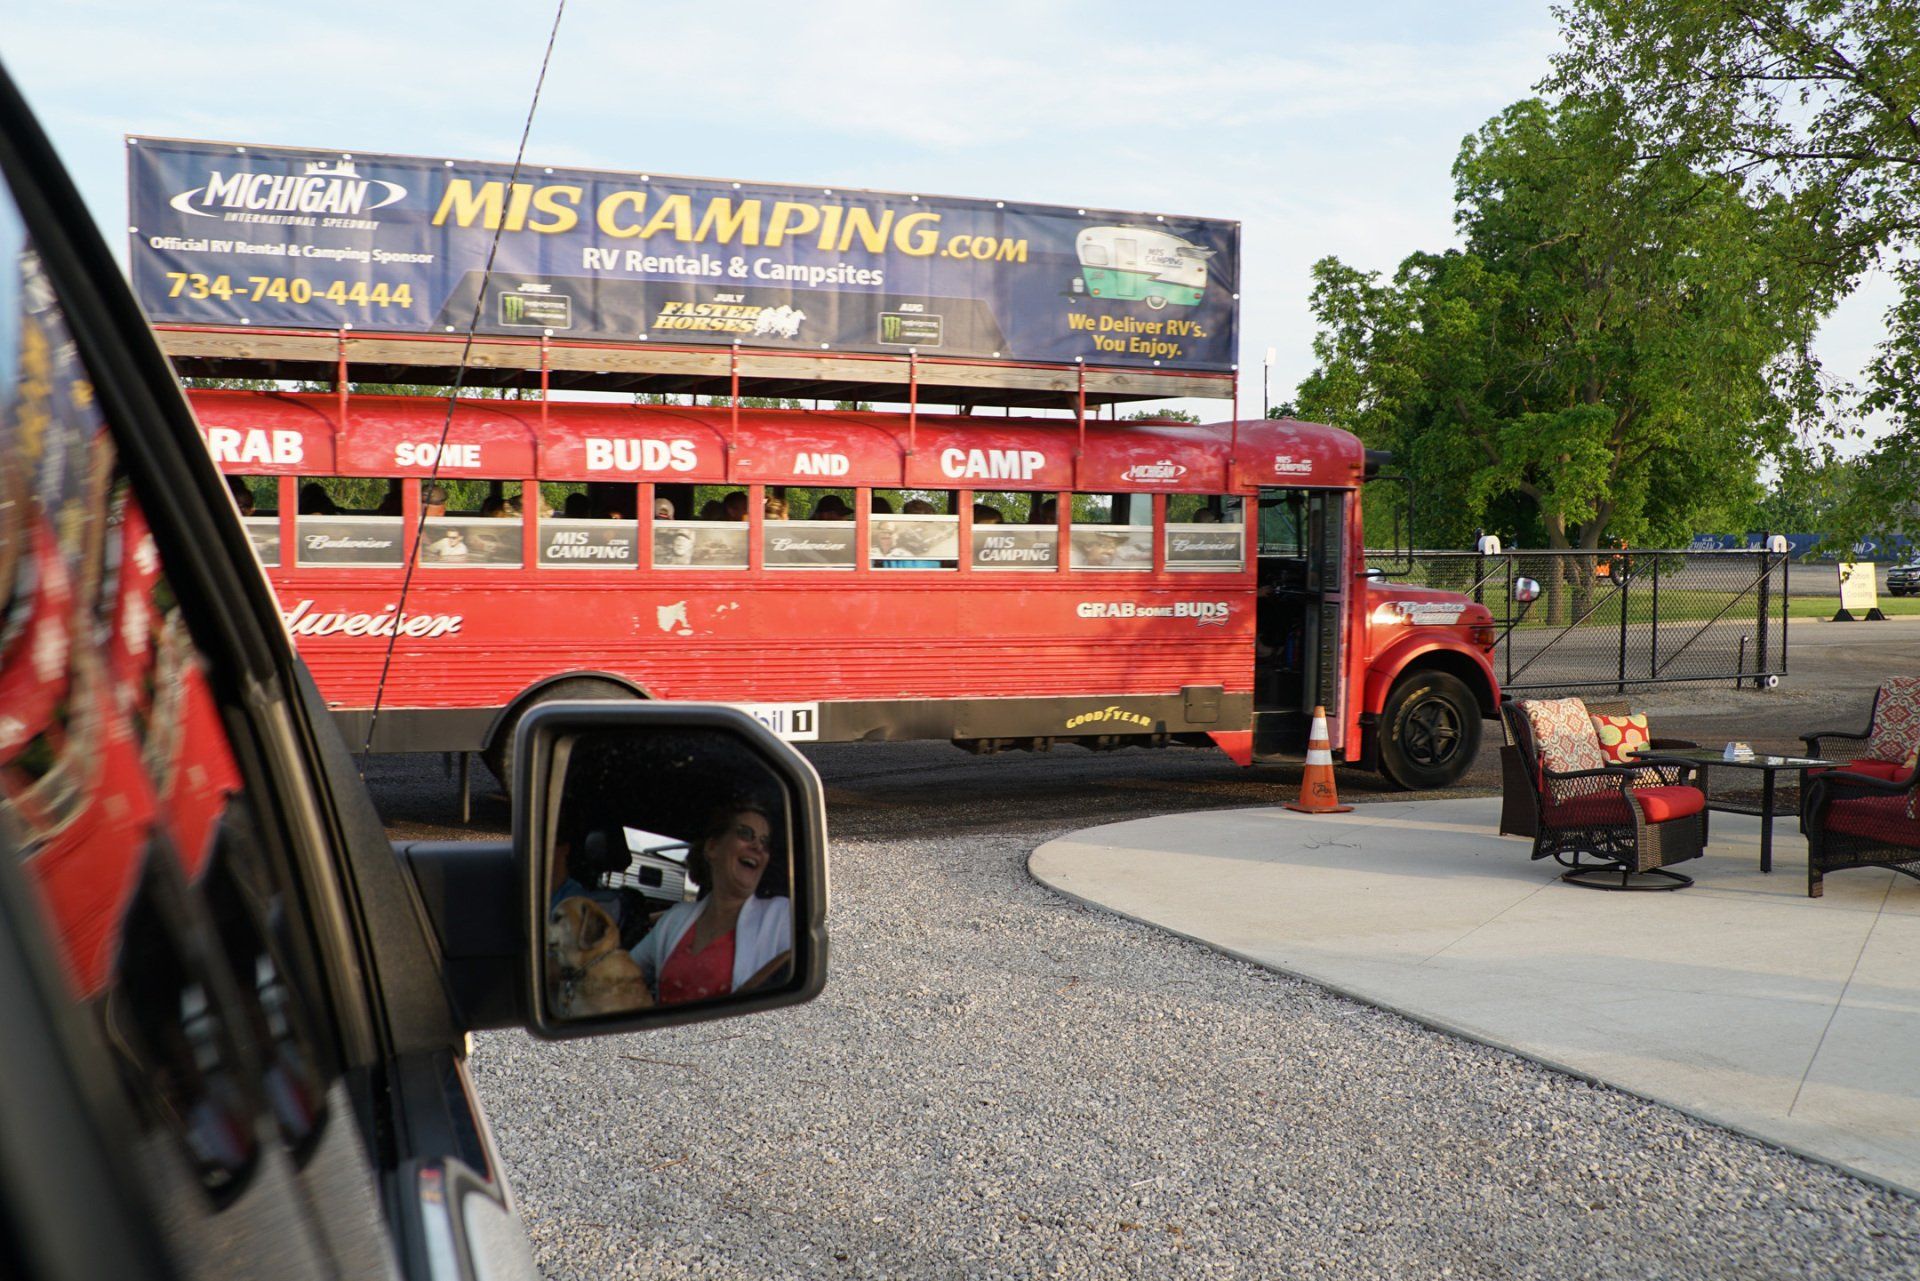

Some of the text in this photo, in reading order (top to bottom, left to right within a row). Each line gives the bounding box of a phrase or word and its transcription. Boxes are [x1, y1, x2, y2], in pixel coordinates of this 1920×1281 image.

[201, 171, 370, 214] MICHIGAN
[432, 179, 583, 234] MIS
[224, 212, 380, 230] INTERNATIONAL SPEEDWAY
[150, 236, 434, 264] Official RV Rental & Camping Sponsor
[582, 247, 883, 288] RV Rentals & Campsites
[166, 272, 413, 308] 734-740-4444
[659, 301, 762, 320] FASTER
[652, 316, 756, 333] HORSES
[1068, 313, 1096, 331] We
[1100, 316, 1163, 335] Deliver
[1092, 334, 1182, 358] You Enjoy.
[202, 427, 1046, 480] RAB SOME BUDS AND CAMP
[304, 534, 392, 551] Budweiser
[552, 532, 589, 545] MIS
[771, 537, 847, 552] Budweiser
[983, 536, 1016, 549] MIS
[1172, 539, 1236, 552] Budweiser
[546, 545, 630, 559] CAMPING
[979, 548, 1051, 561] CAMPING
[283, 599, 464, 638] dweiser
[1077, 602, 1230, 618] GRAB SOME BUDS
